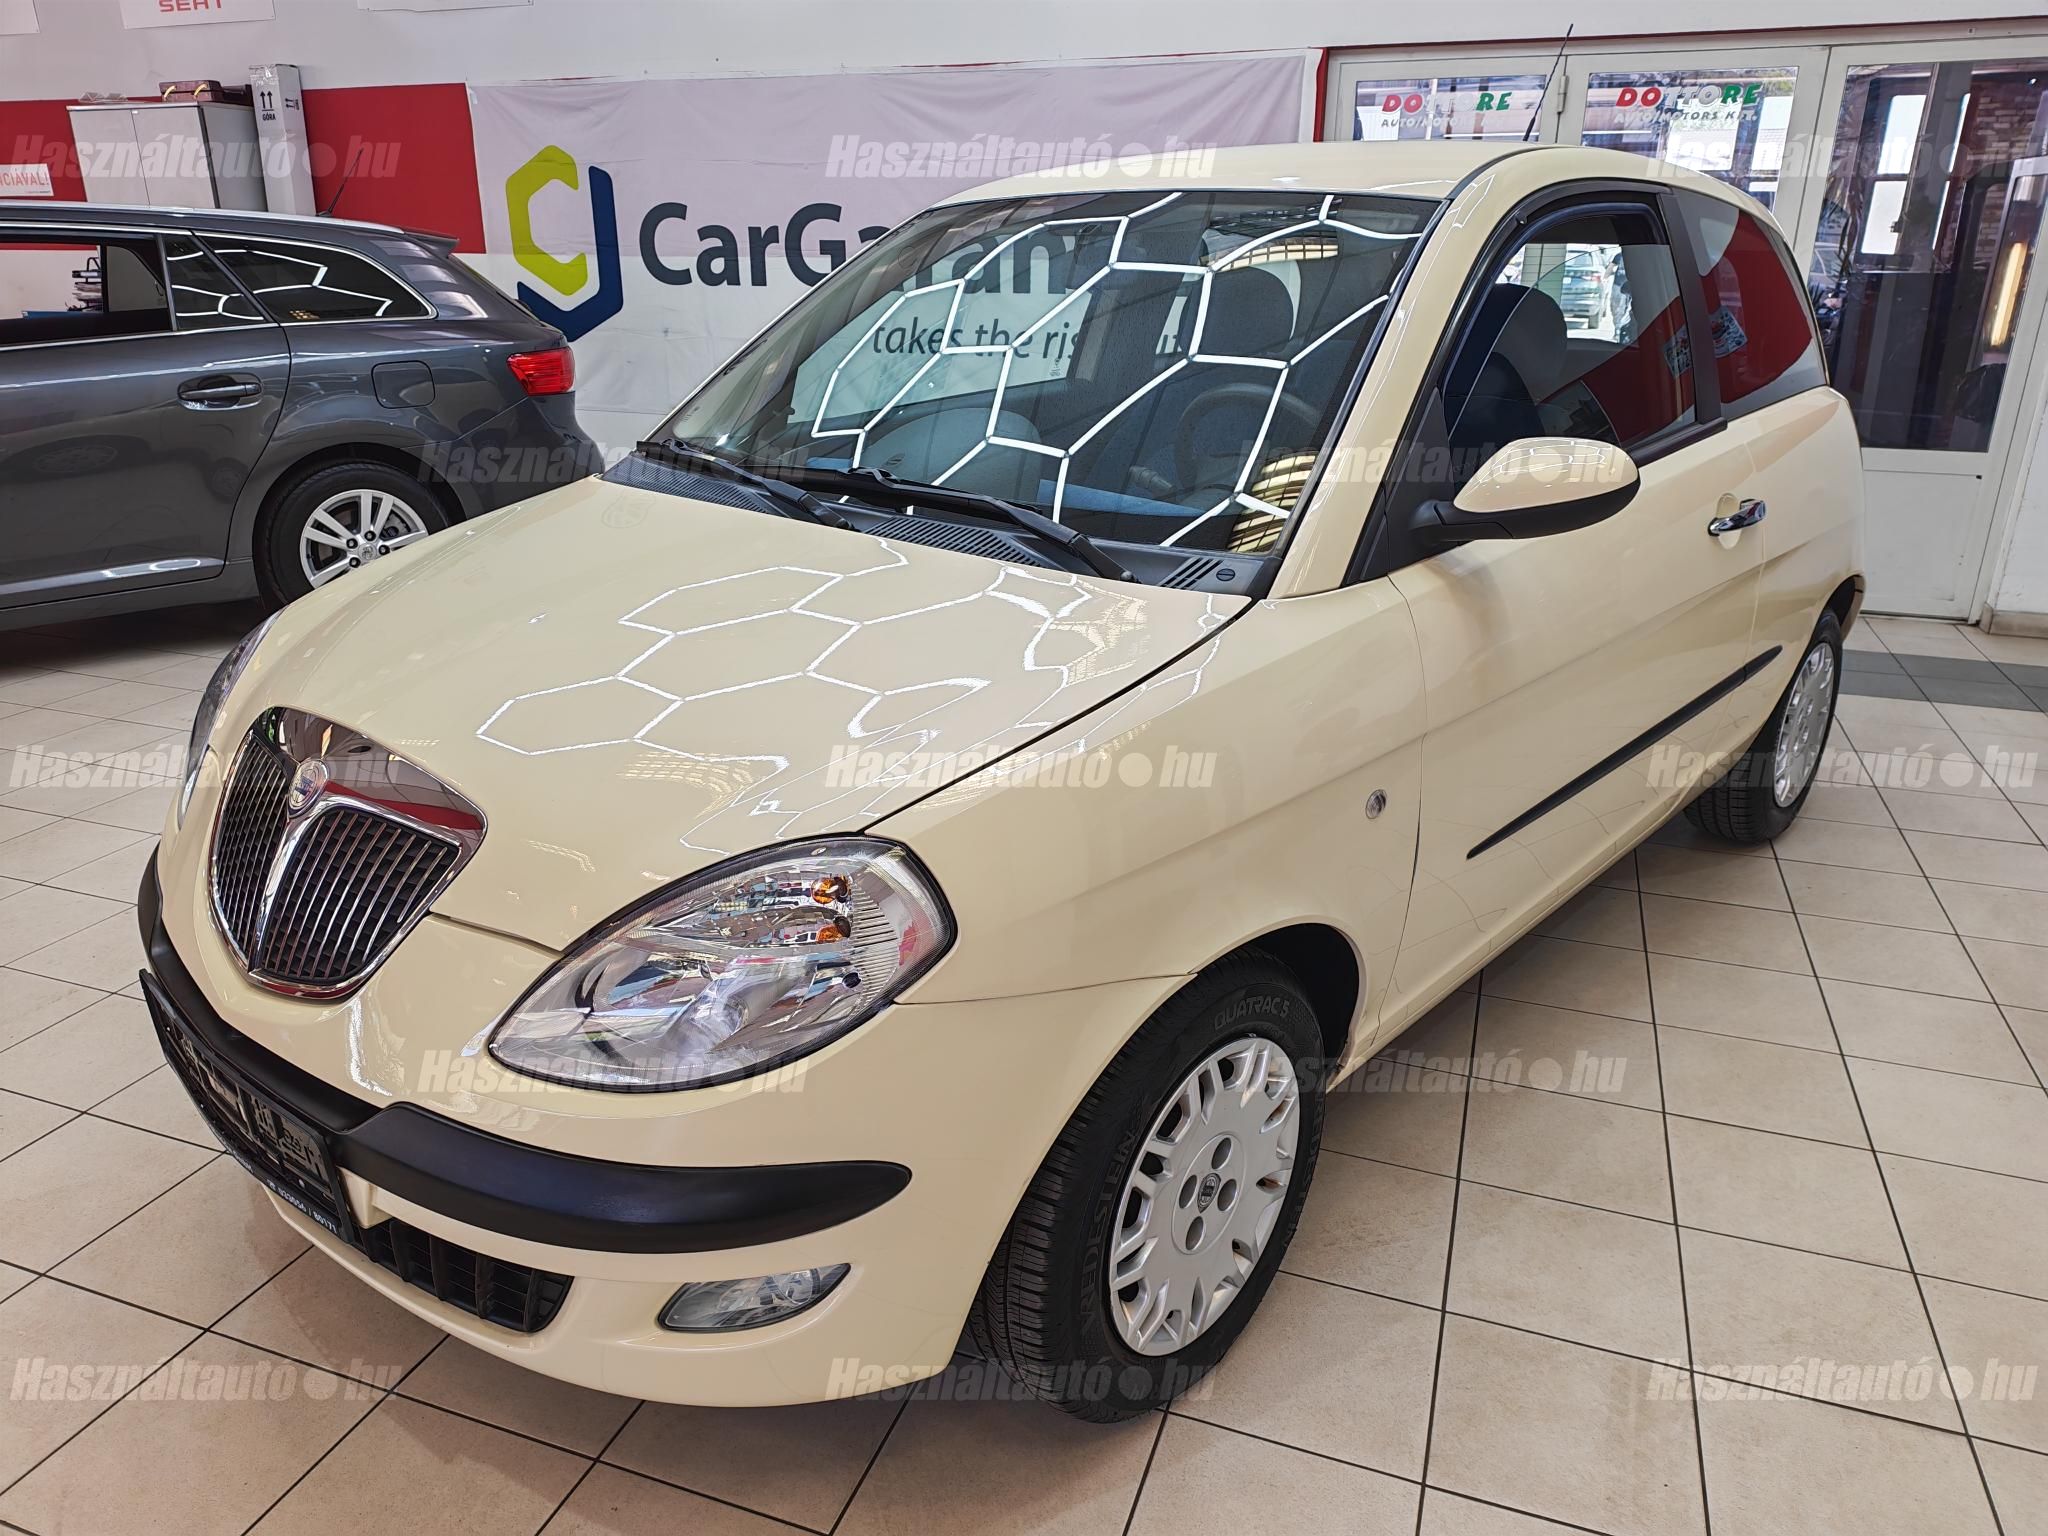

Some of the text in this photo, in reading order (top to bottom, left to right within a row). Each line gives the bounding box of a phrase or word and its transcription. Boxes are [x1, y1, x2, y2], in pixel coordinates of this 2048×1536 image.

[1615, 82, 1763, 109] DOTTORE
[262, 112, 276, 121] GÓRA
[1613, 110, 1719, 125] AUTO/MOTORS
[873, 317, 963, 355] takes
[975, 318, 1030, 360] the
